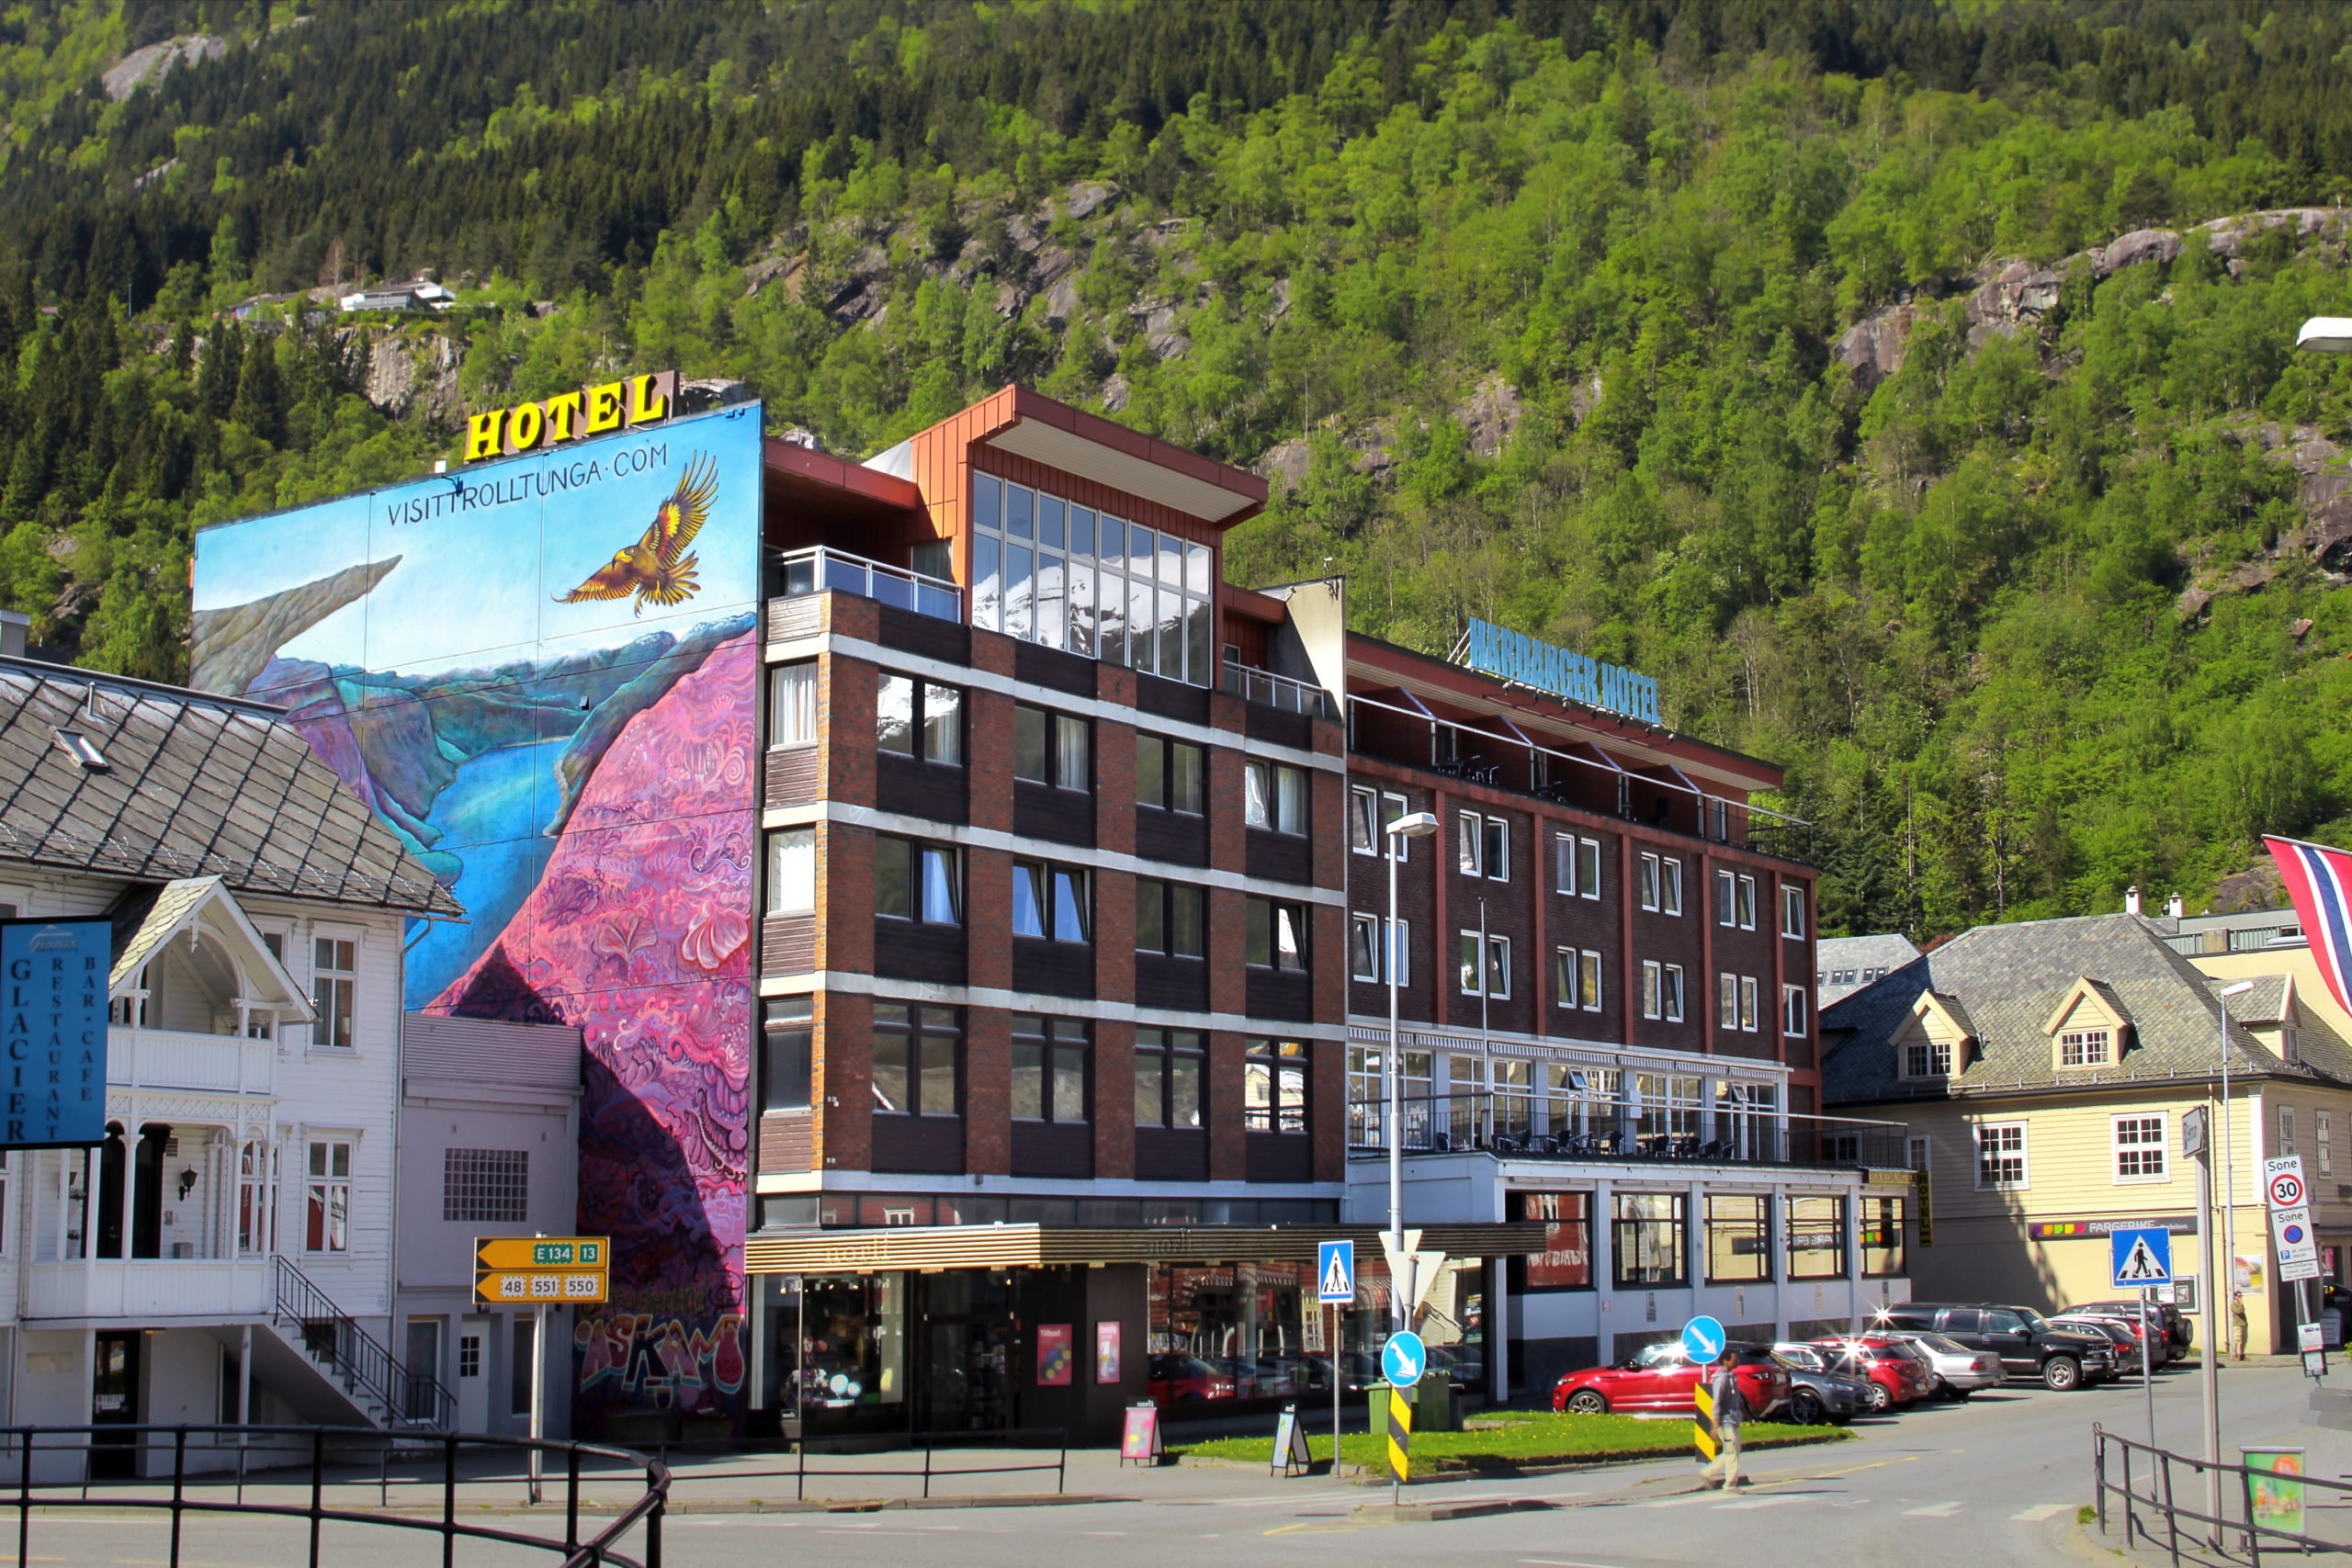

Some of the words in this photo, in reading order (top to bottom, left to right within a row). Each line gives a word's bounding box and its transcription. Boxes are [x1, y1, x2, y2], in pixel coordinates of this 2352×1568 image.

[465, 374, 668, 460] HOTEL
[1470, 616, 1600, 705] HARDANGER
[1601, 661, 1662, 725] HOTEL
[83, 956, 95, 1008] BAR
[7, 959, 31, 1141] GLACIER
[46, 957, 63, 1140] RESTAURANT
[81, 1031, 95, 1101] CAFE
[2268, 1160, 2297, 1171] Sone
[2277, 1181, 2297, 1198] 30
[1919, 1172, 1928, 1227] HOTEL
[2278, 1213, 2303, 1223] Sone
[2089, 1220, 2155, 1233] FARGERIKE
[537, 1247, 545, 1259] E
[549, 1247, 570, 1259] 134
[582, 1247, 595, 1259] 13
[504, 1280, 522, 1292] 48
[535, 1280, 556, 1292] 551
[569, 1280, 594, 1292] 550
[1039, 1329, 1061, 1337] Tilbud
